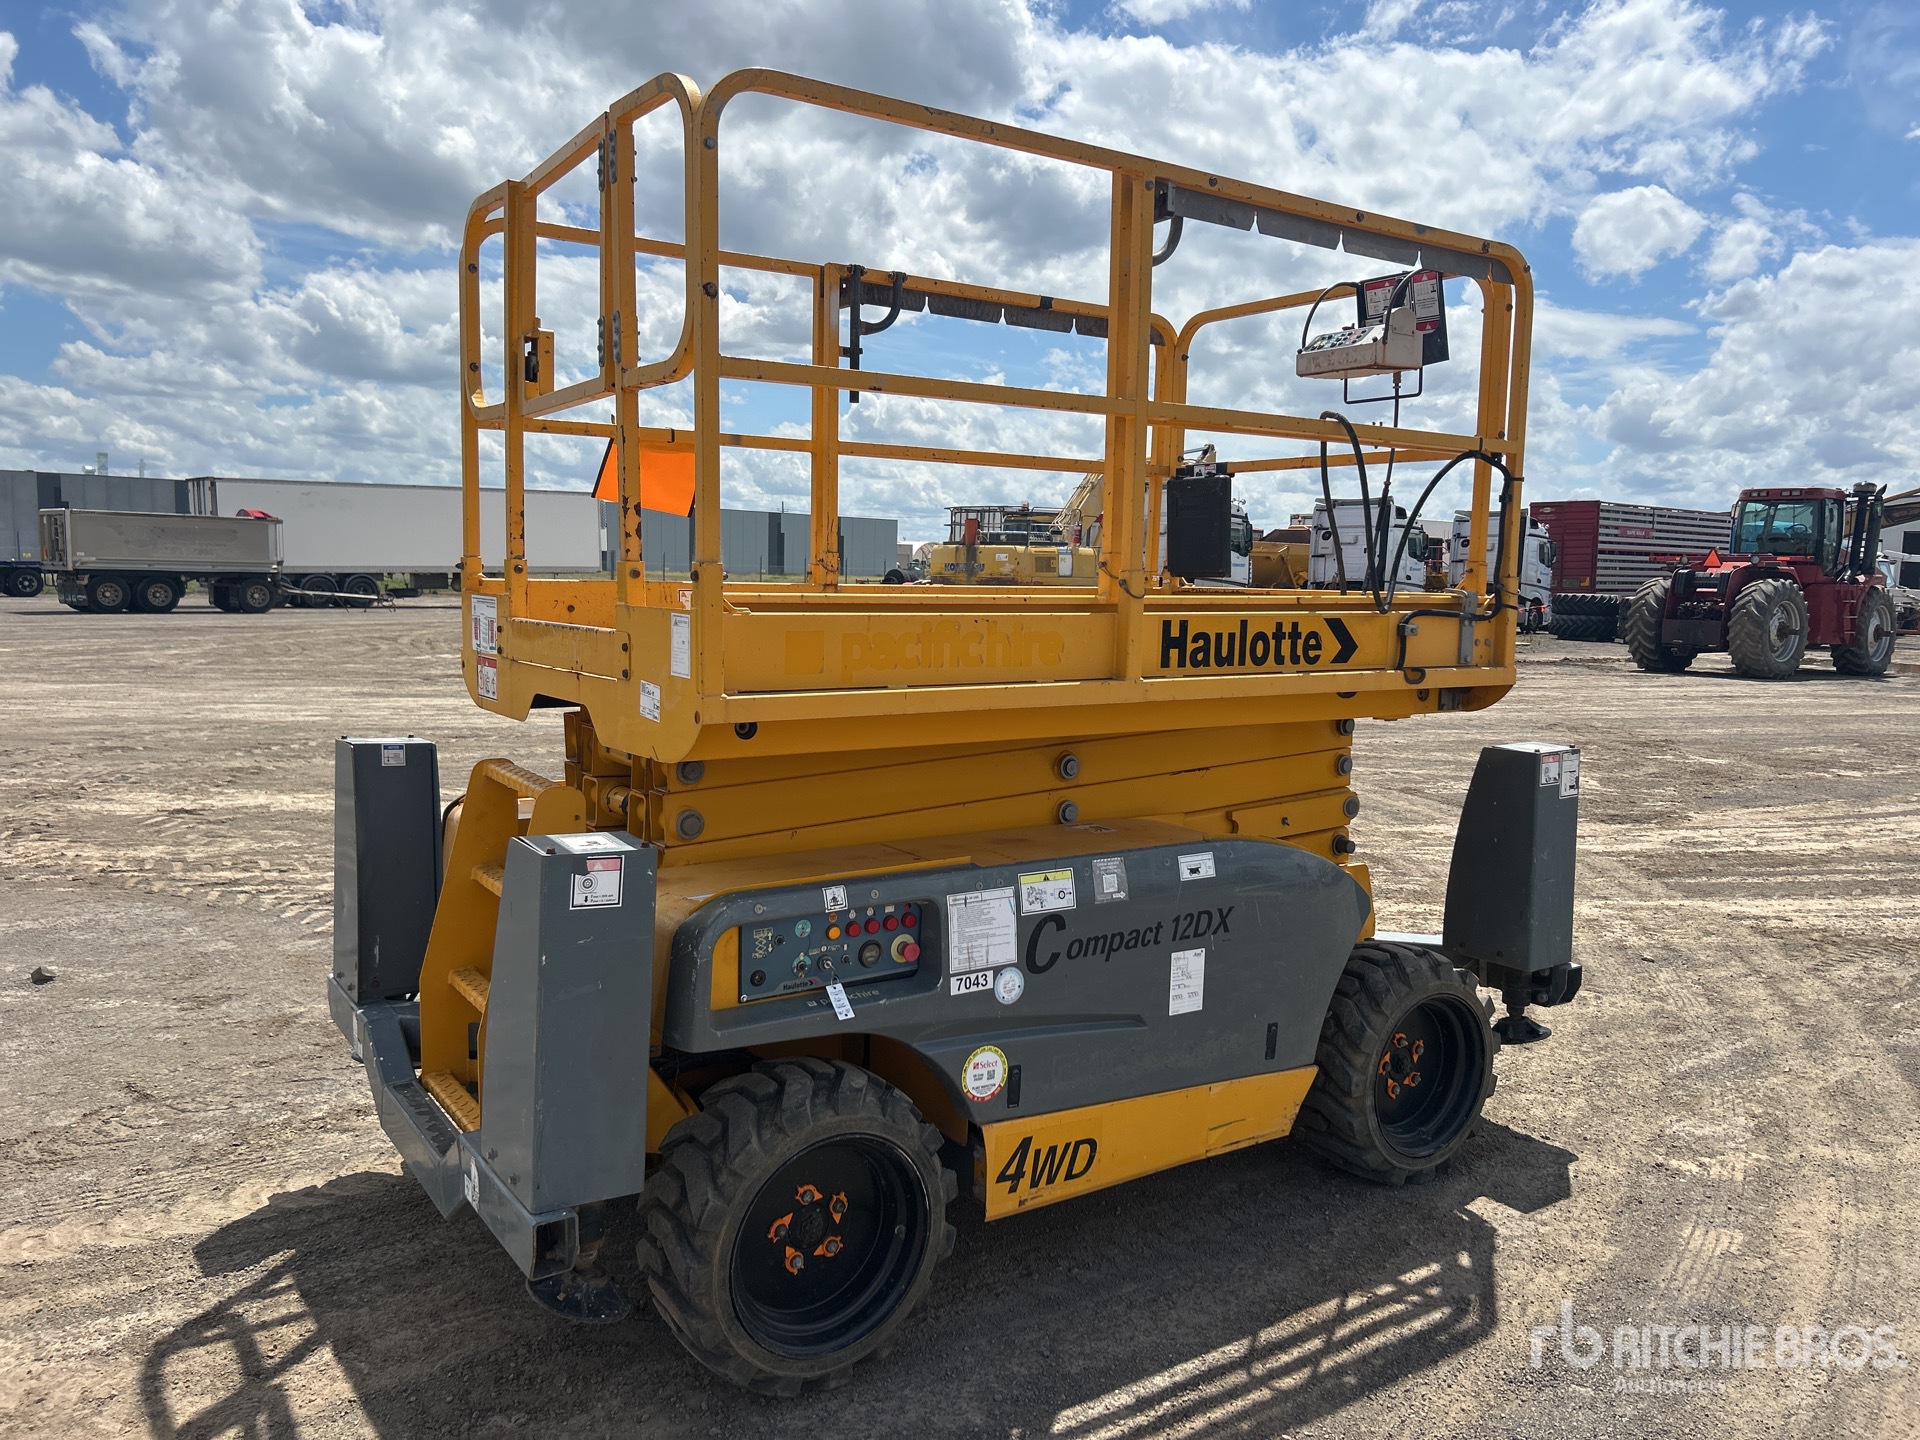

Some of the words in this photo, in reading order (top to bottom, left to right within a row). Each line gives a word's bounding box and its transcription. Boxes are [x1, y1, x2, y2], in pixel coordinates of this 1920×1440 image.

[944, 562, 985, 572] KOMASU
[1160, 619, 1323, 669] Haulotte
[1026, 914, 1164, 974] Compact
[1171, 906, 1235, 941] 12DX
[783, 982, 808, 991] Haulotte
[956, 973, 989, 992] 7043
[980, 1060, 997, 1068] Select
[995, 1136, 1098, 1194] 4WD
